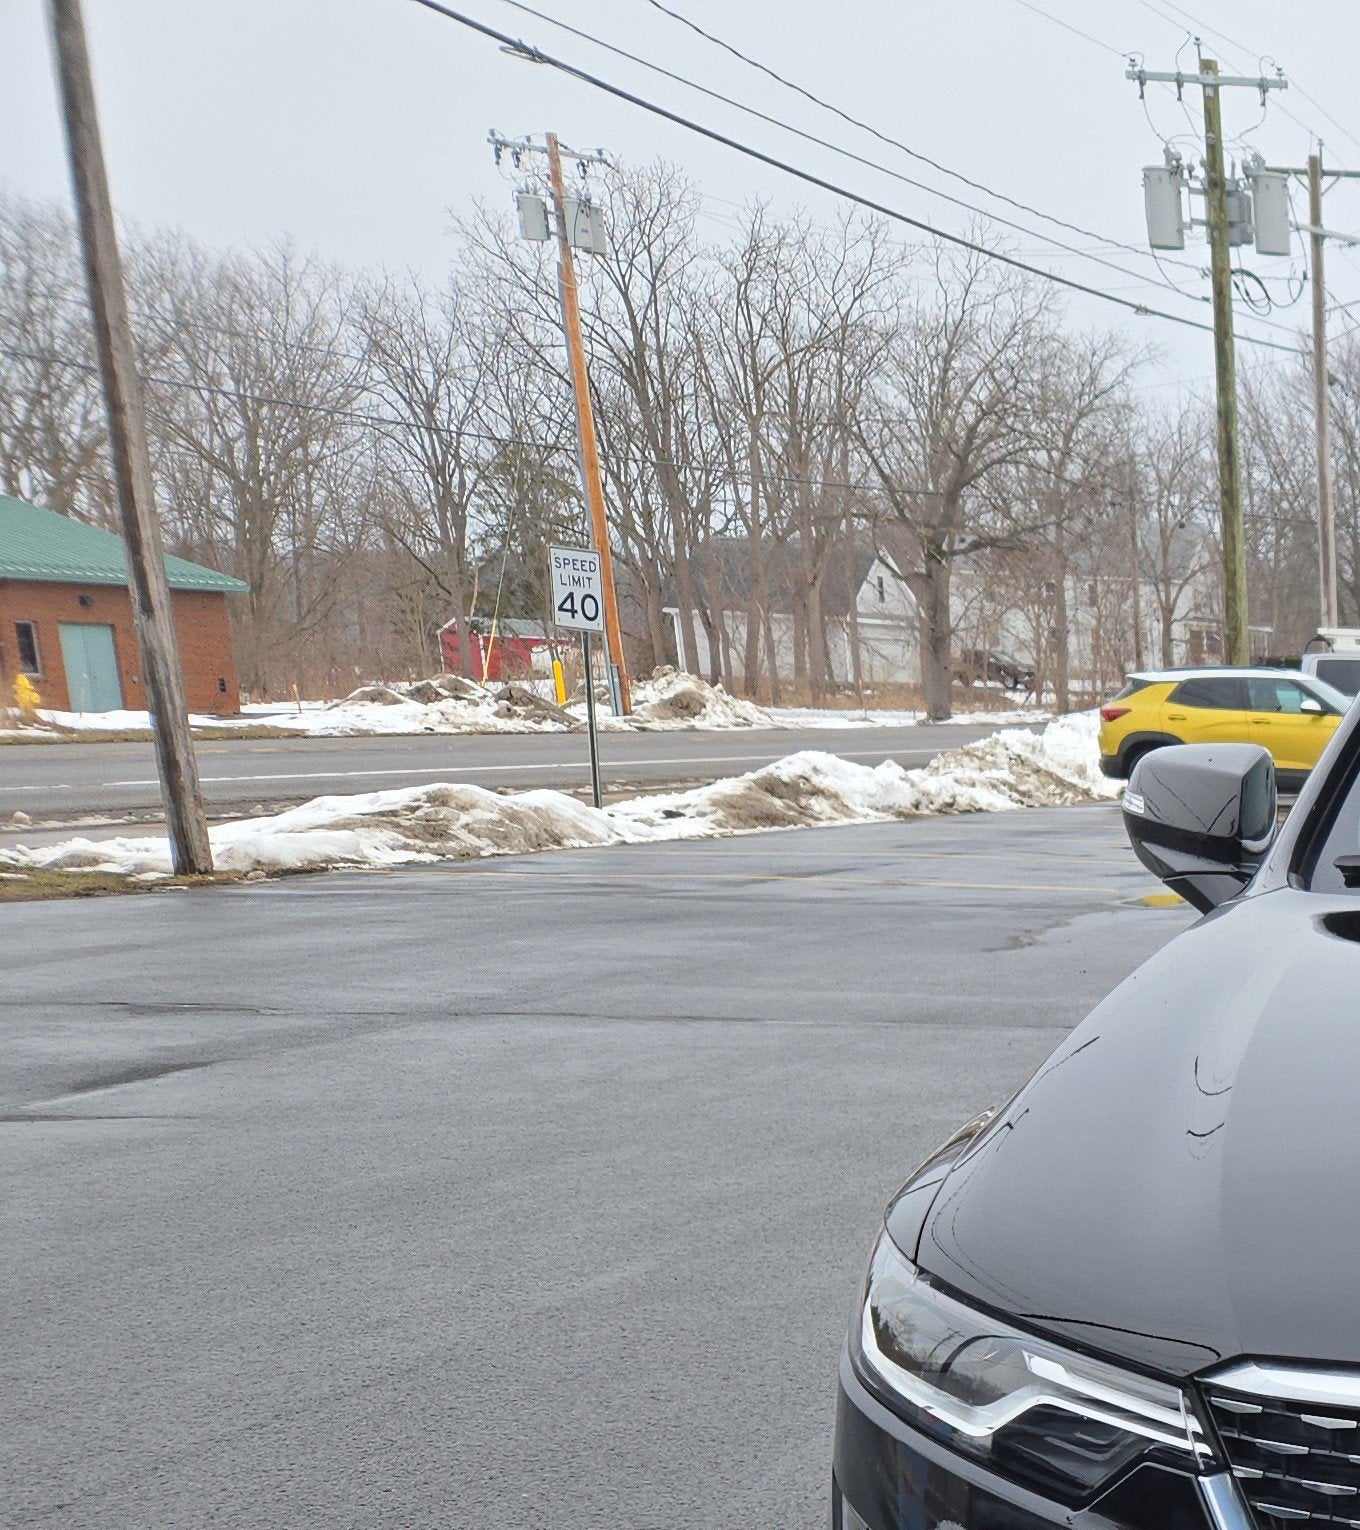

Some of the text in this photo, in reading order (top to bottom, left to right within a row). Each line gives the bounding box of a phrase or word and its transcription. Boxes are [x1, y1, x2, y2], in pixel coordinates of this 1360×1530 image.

[554, 556, 597, 572] SPEED
[560, 573, 593, 588] LIMIT
[557, 591, 599, 621] 40
